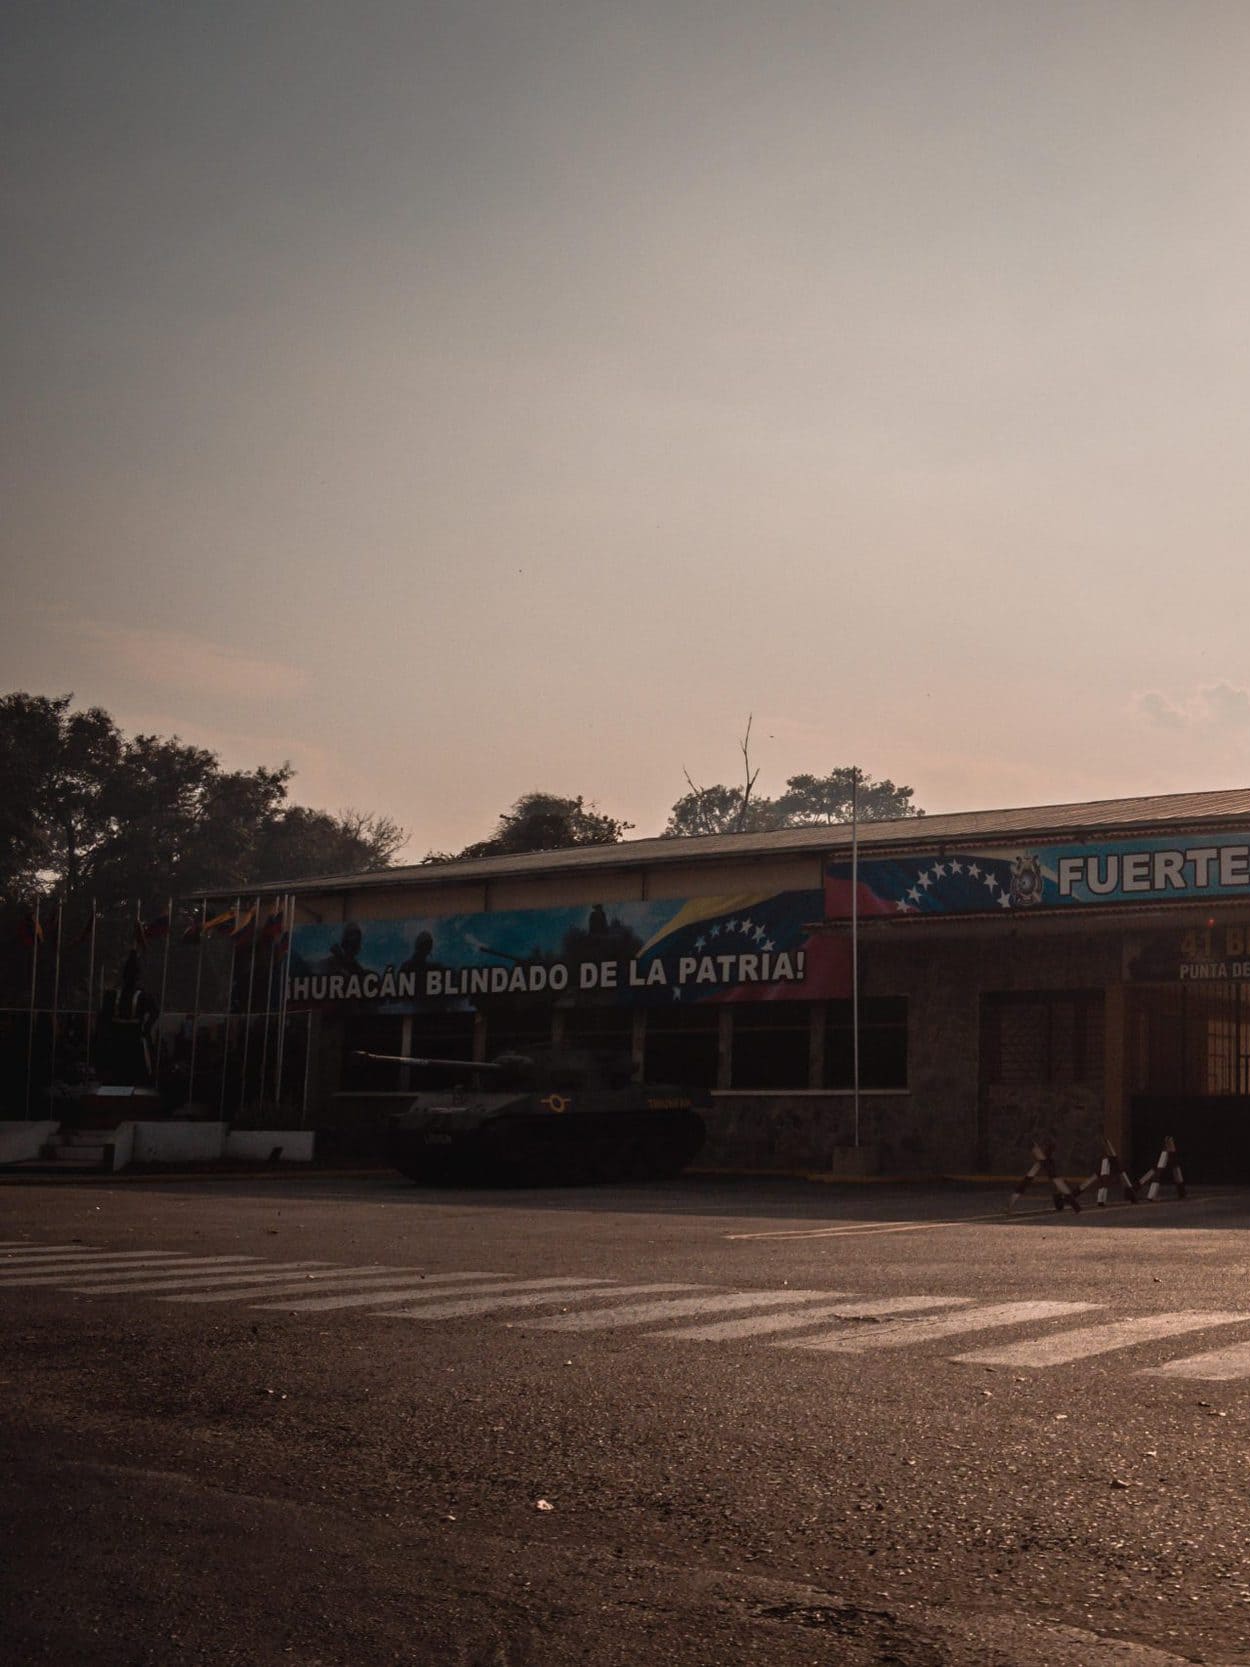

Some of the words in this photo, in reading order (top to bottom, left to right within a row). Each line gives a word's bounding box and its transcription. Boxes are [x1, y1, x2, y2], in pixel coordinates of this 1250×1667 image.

[1058, 845, 1250, 895] FUERTE
[1180, 928, 1213, 957] 41
[425, 963, 569, 995] BLINDADO
[579, 961, 618, 989] DE
[628, 957, 667, 986] LA
[678, 950, 806, 984] PATRIA!
[1179, 960, 1228, 980] PUNTA
